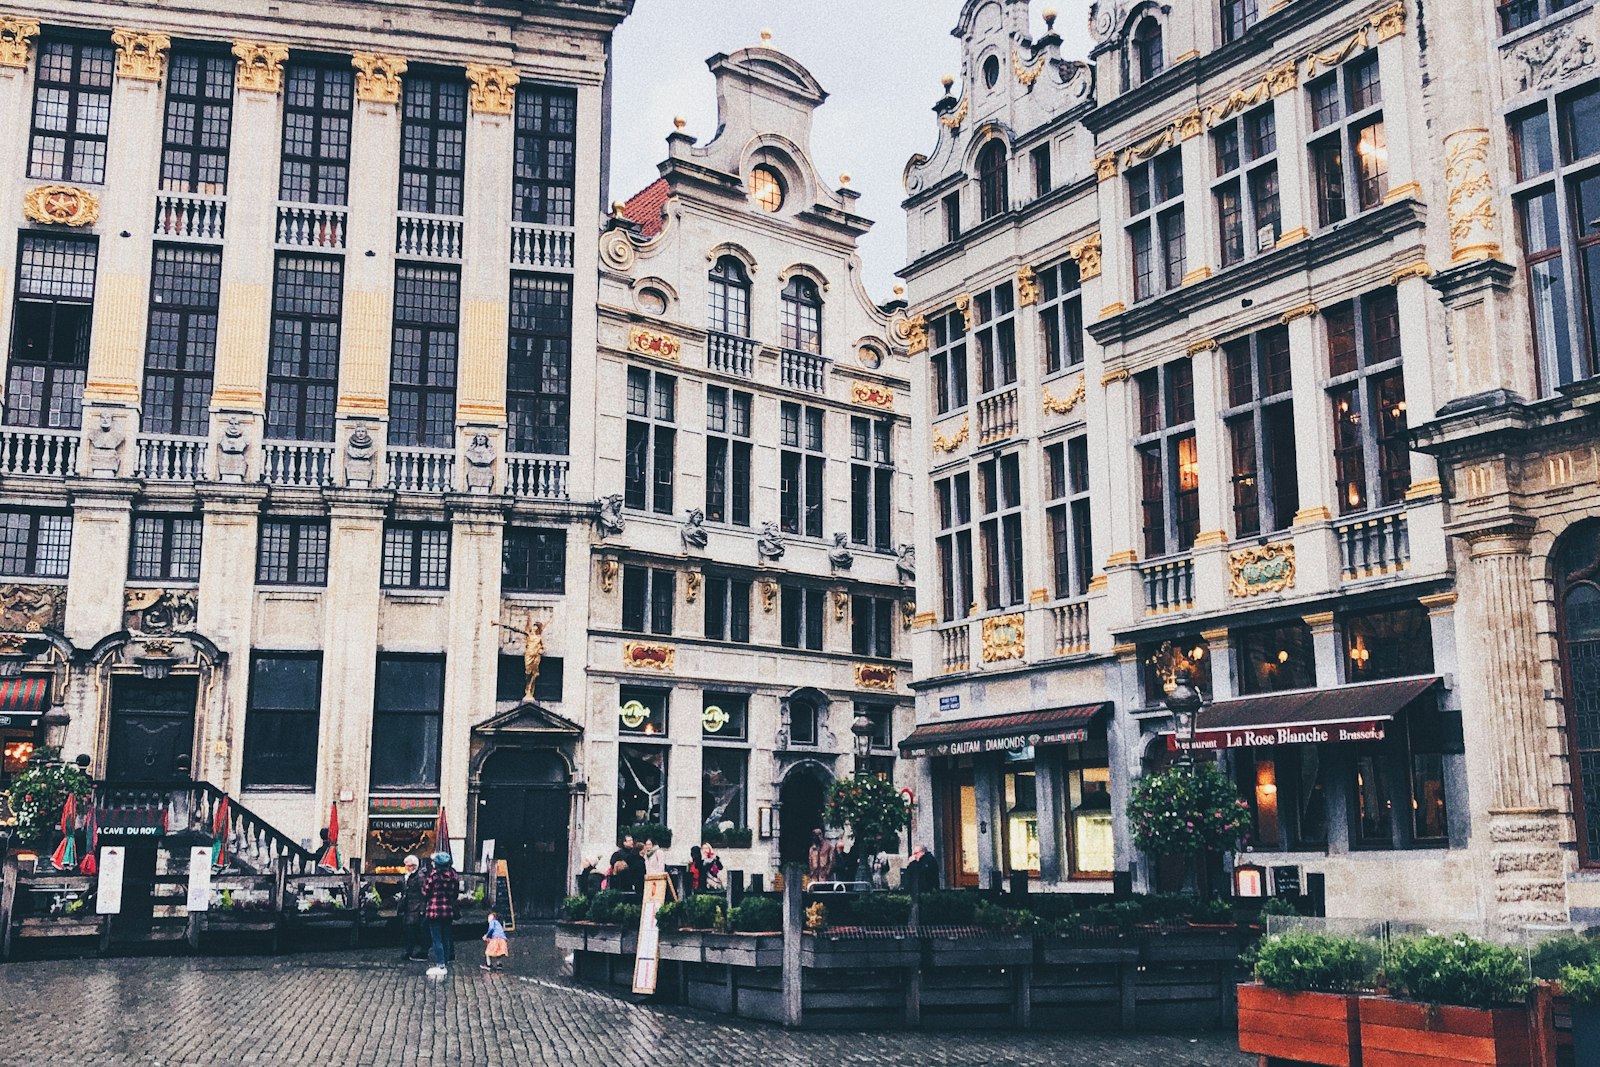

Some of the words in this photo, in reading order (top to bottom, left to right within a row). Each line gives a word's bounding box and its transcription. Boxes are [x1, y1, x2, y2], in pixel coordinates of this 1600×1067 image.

[950, 740, 981, 755] GAUTAM
[985, 735, 1025, 752] DIAMONDS
[1226, 732, 1242, 747] La
[1244, 730, 1275, 747] Rose
[1277, 727, 1328, 744] Blanche
[103, 827, 124, 835] CAVE
[126, 827, 139, 835] DU
[140, 827, 157, 835] ROY
